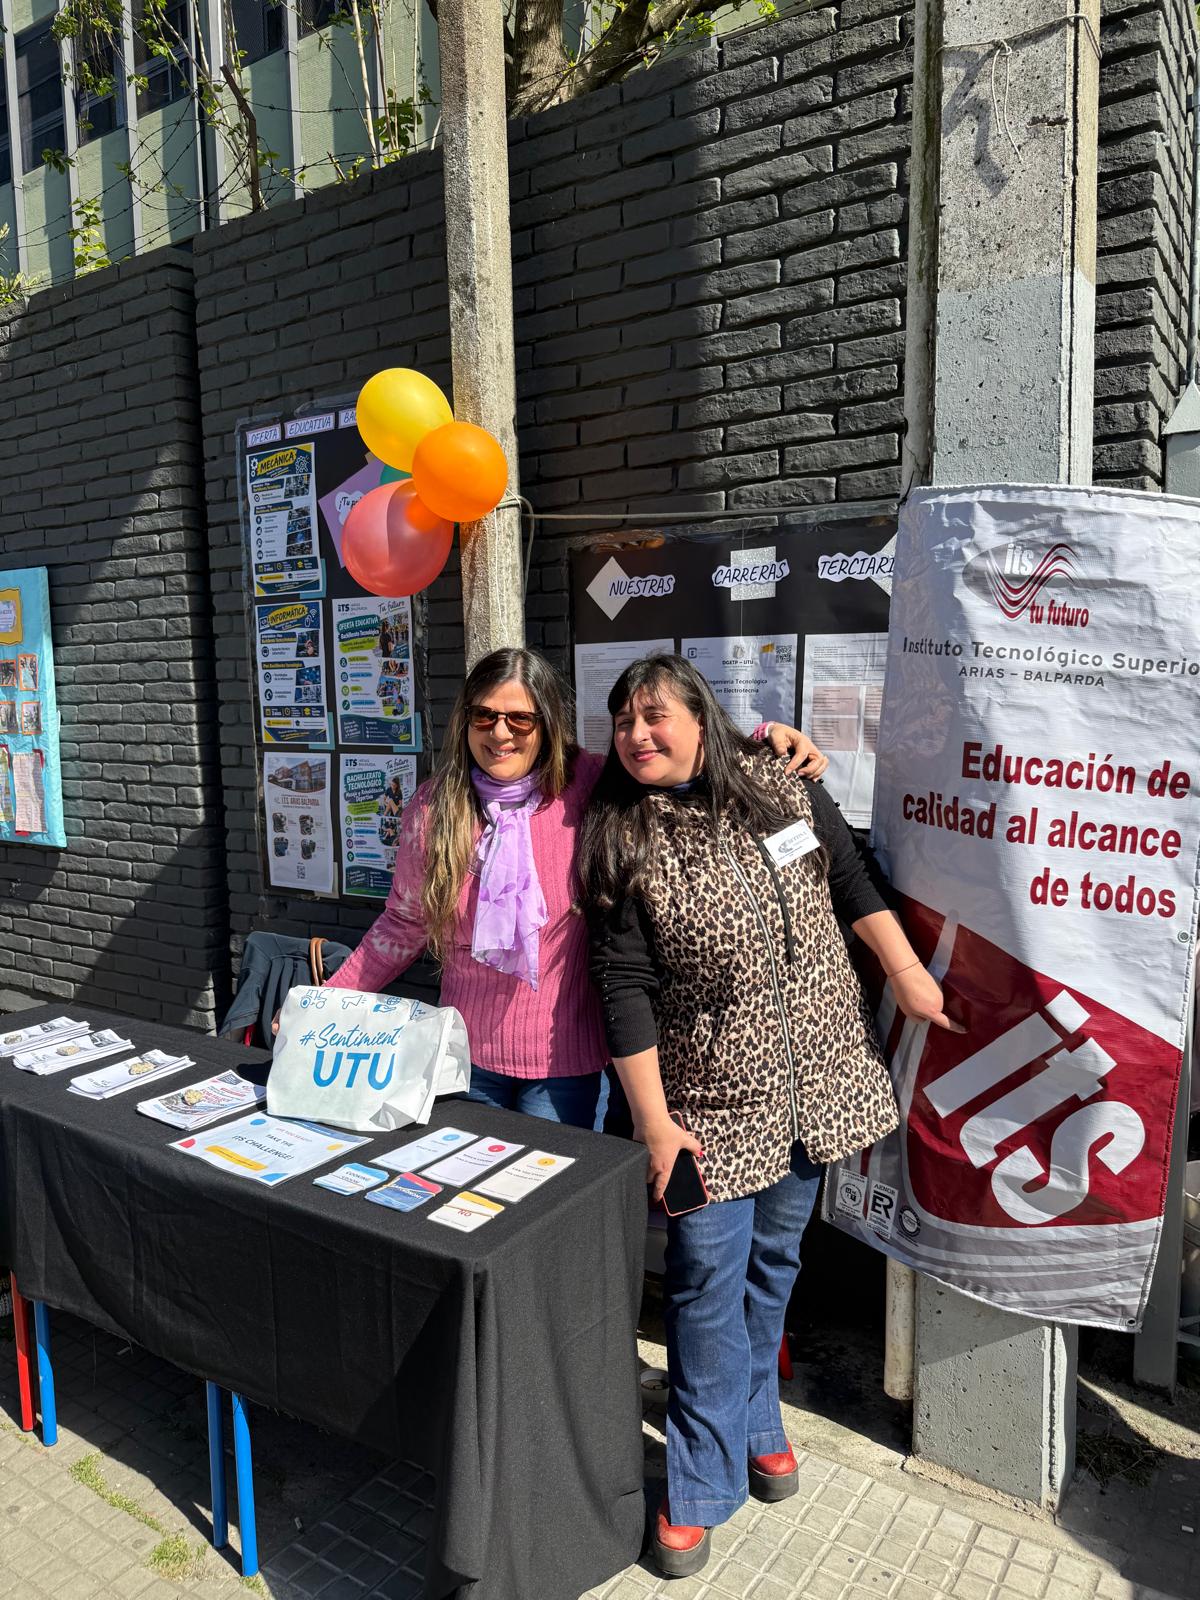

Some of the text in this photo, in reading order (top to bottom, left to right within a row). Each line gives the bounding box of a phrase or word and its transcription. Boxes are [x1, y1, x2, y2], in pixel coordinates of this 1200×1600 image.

[250, 428, 279, 445] OFERTA
[289, 416, 332, 435] EDUCATIVA
[260, 450, 295, 473] MECÁNICA
[714, 561, 787, 586] CARRERAS
[819, 556, 895, 577] TERCIARI
[608, 576, 675, 597] NUESTRAS
[270, 606, 306, 624] INFORMÁTICA
[1029, 599, 1090, 628] tu futuro
[902, 637, 1200, 677] Instituto Tecnológico Superio
[958, 667, 1005, 679] ARIAS
[1023, 669, 1105, 687] BALPARDA
[961, 742, 1191, 800] Educación de
[902, 792, 1182, 859] calidad al alcance
[1029, 867, 1177, 918] de todos
[312, 1050, 396, 1091] UTU
[245, 1138, 296, 1161] CHALLENGE!
[874, 1183, 896, 1196] AENOR
